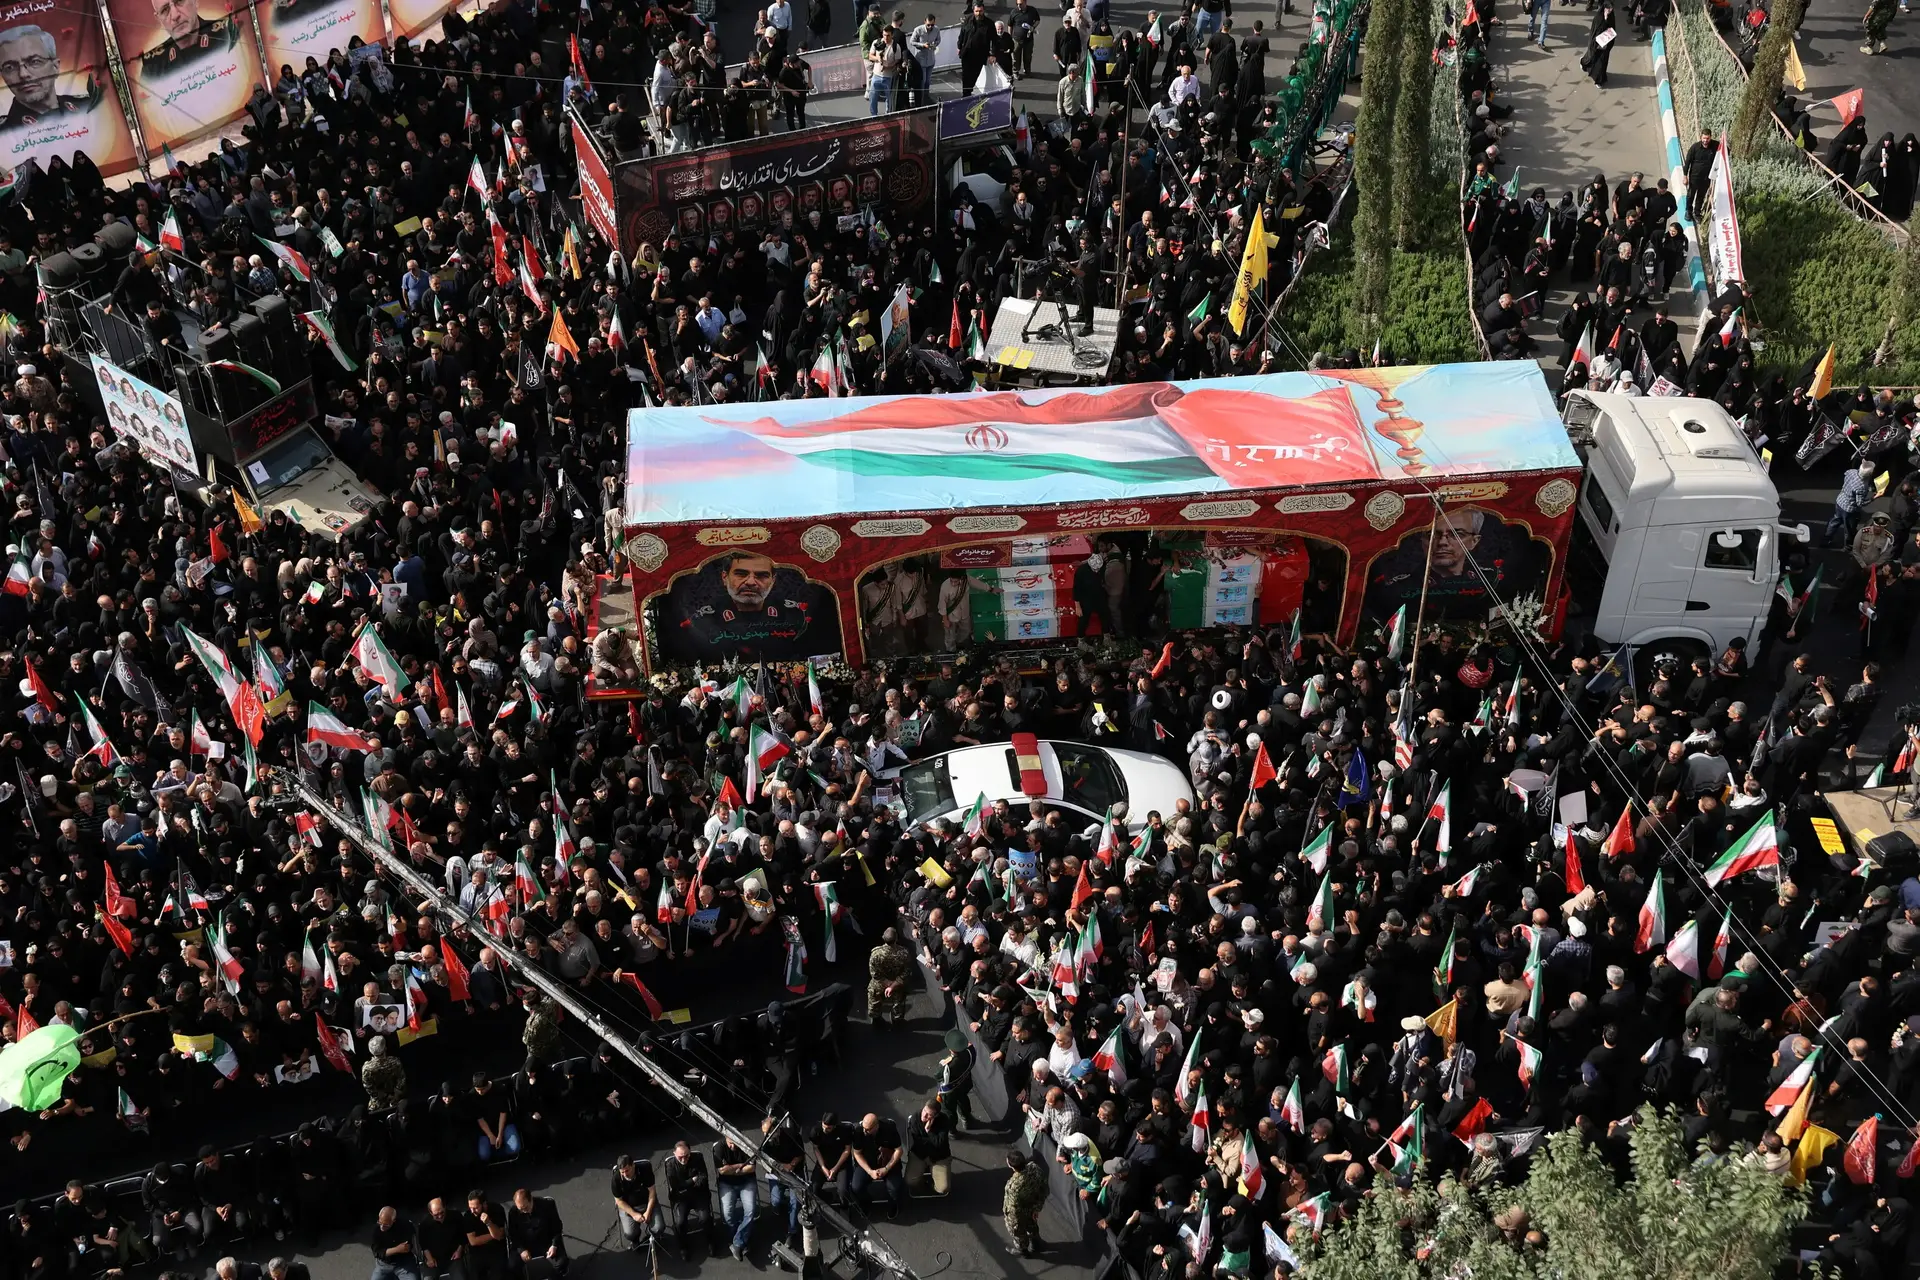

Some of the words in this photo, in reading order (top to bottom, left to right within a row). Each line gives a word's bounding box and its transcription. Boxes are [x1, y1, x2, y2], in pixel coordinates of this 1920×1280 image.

[338, 10, 356, 23] شهید
[291, 32, 309, 44] رشید
[218, 64, 237, 77] شهید
[161, 88, 188, 107] محرابی
[65, 127, 89, 138] شهید
[720, 169, 749, 191] ایران
[709, 630, 741, 644] ربانی
[741, 629, 769, 640] مهدی
[770, 628, 797, 638] شهید
